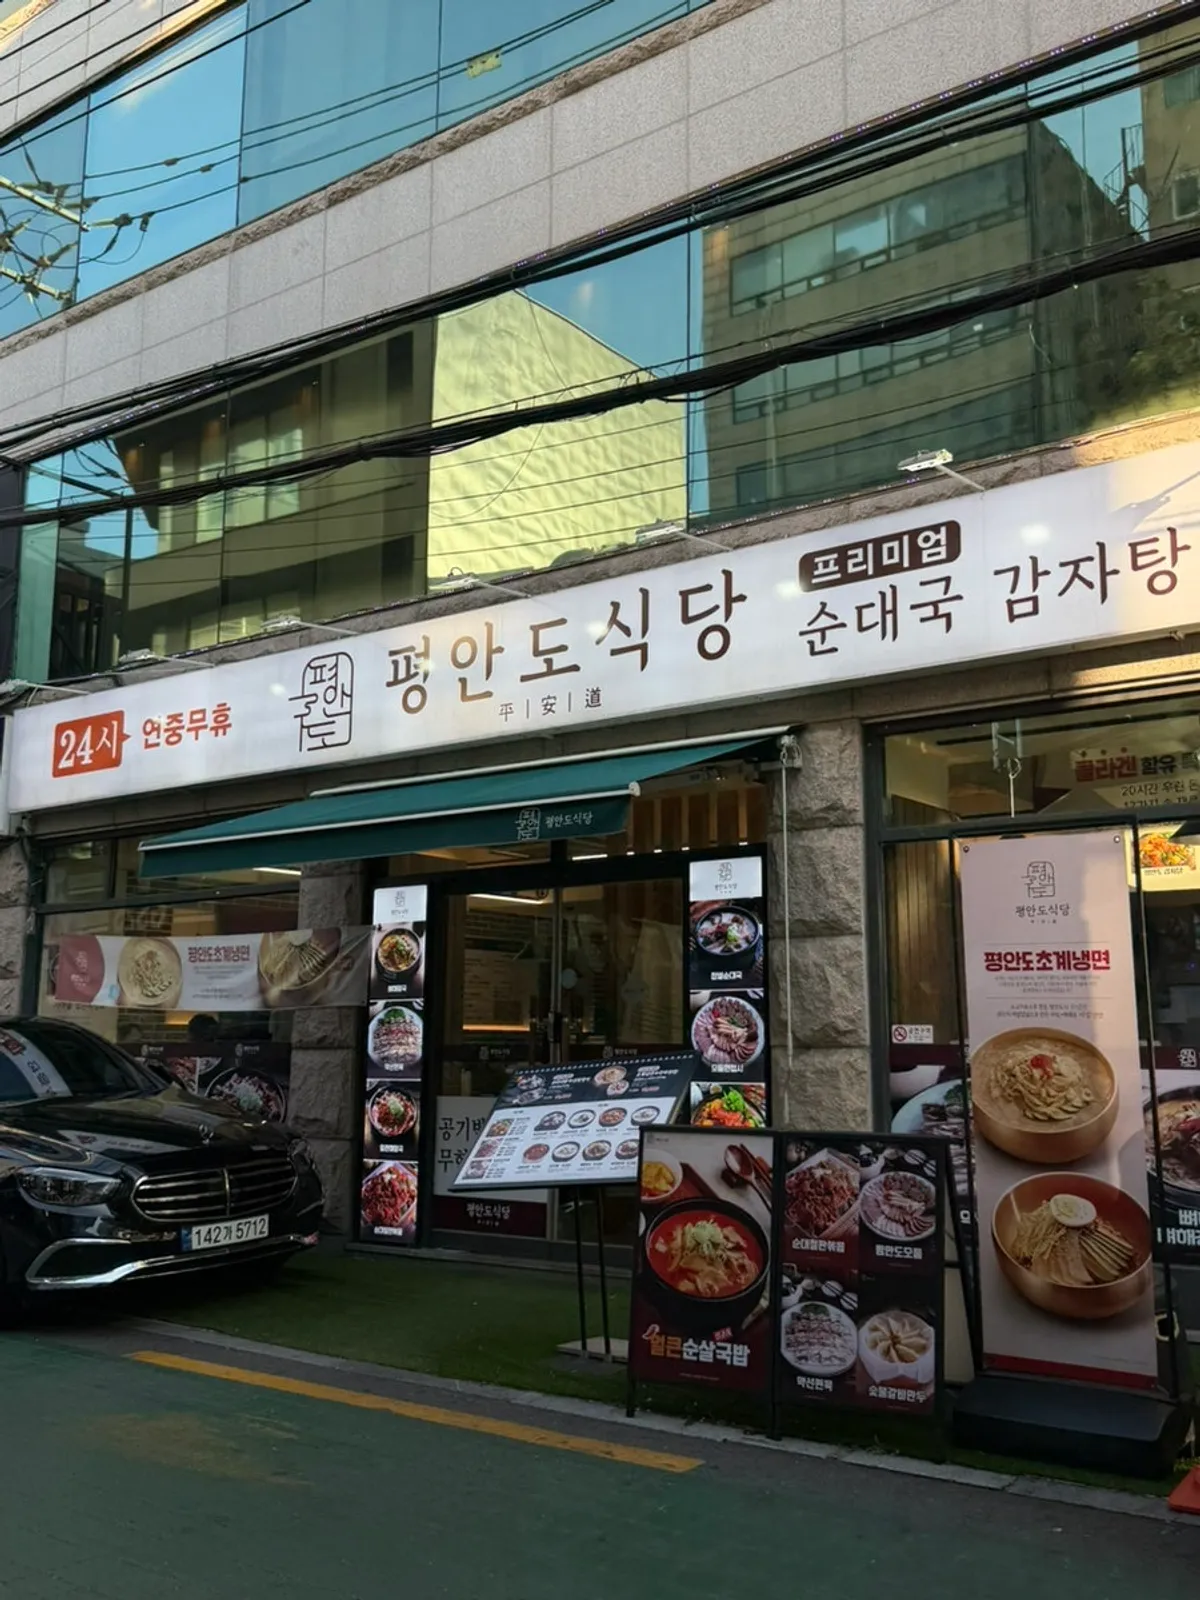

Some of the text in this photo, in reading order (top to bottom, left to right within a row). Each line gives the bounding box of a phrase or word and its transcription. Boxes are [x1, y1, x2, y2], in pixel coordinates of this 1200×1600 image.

[811, 526, 947, 584] 프리미엄
[799, 526, 1192, 657] 순대국 감자탕
[386, 569, 747, 713] 평안도식당
[58, 703, 233, 770] 24시 연중무휴
[1141, 754, 1178, 776] 함유
[1121, 782, 1159, 797] 20시간
[1162, 780, 1185, 793] 우린
[545, 811, 593, 828] 평안도식당
[1015, 903, 1071, 918] 평안도식당
[187, 944, 250, 963] 평안도초계냉면
[983, 950, 1111, 972] 평안도초계냉면
[195, 1218, 266, 1246] 142가 5712
